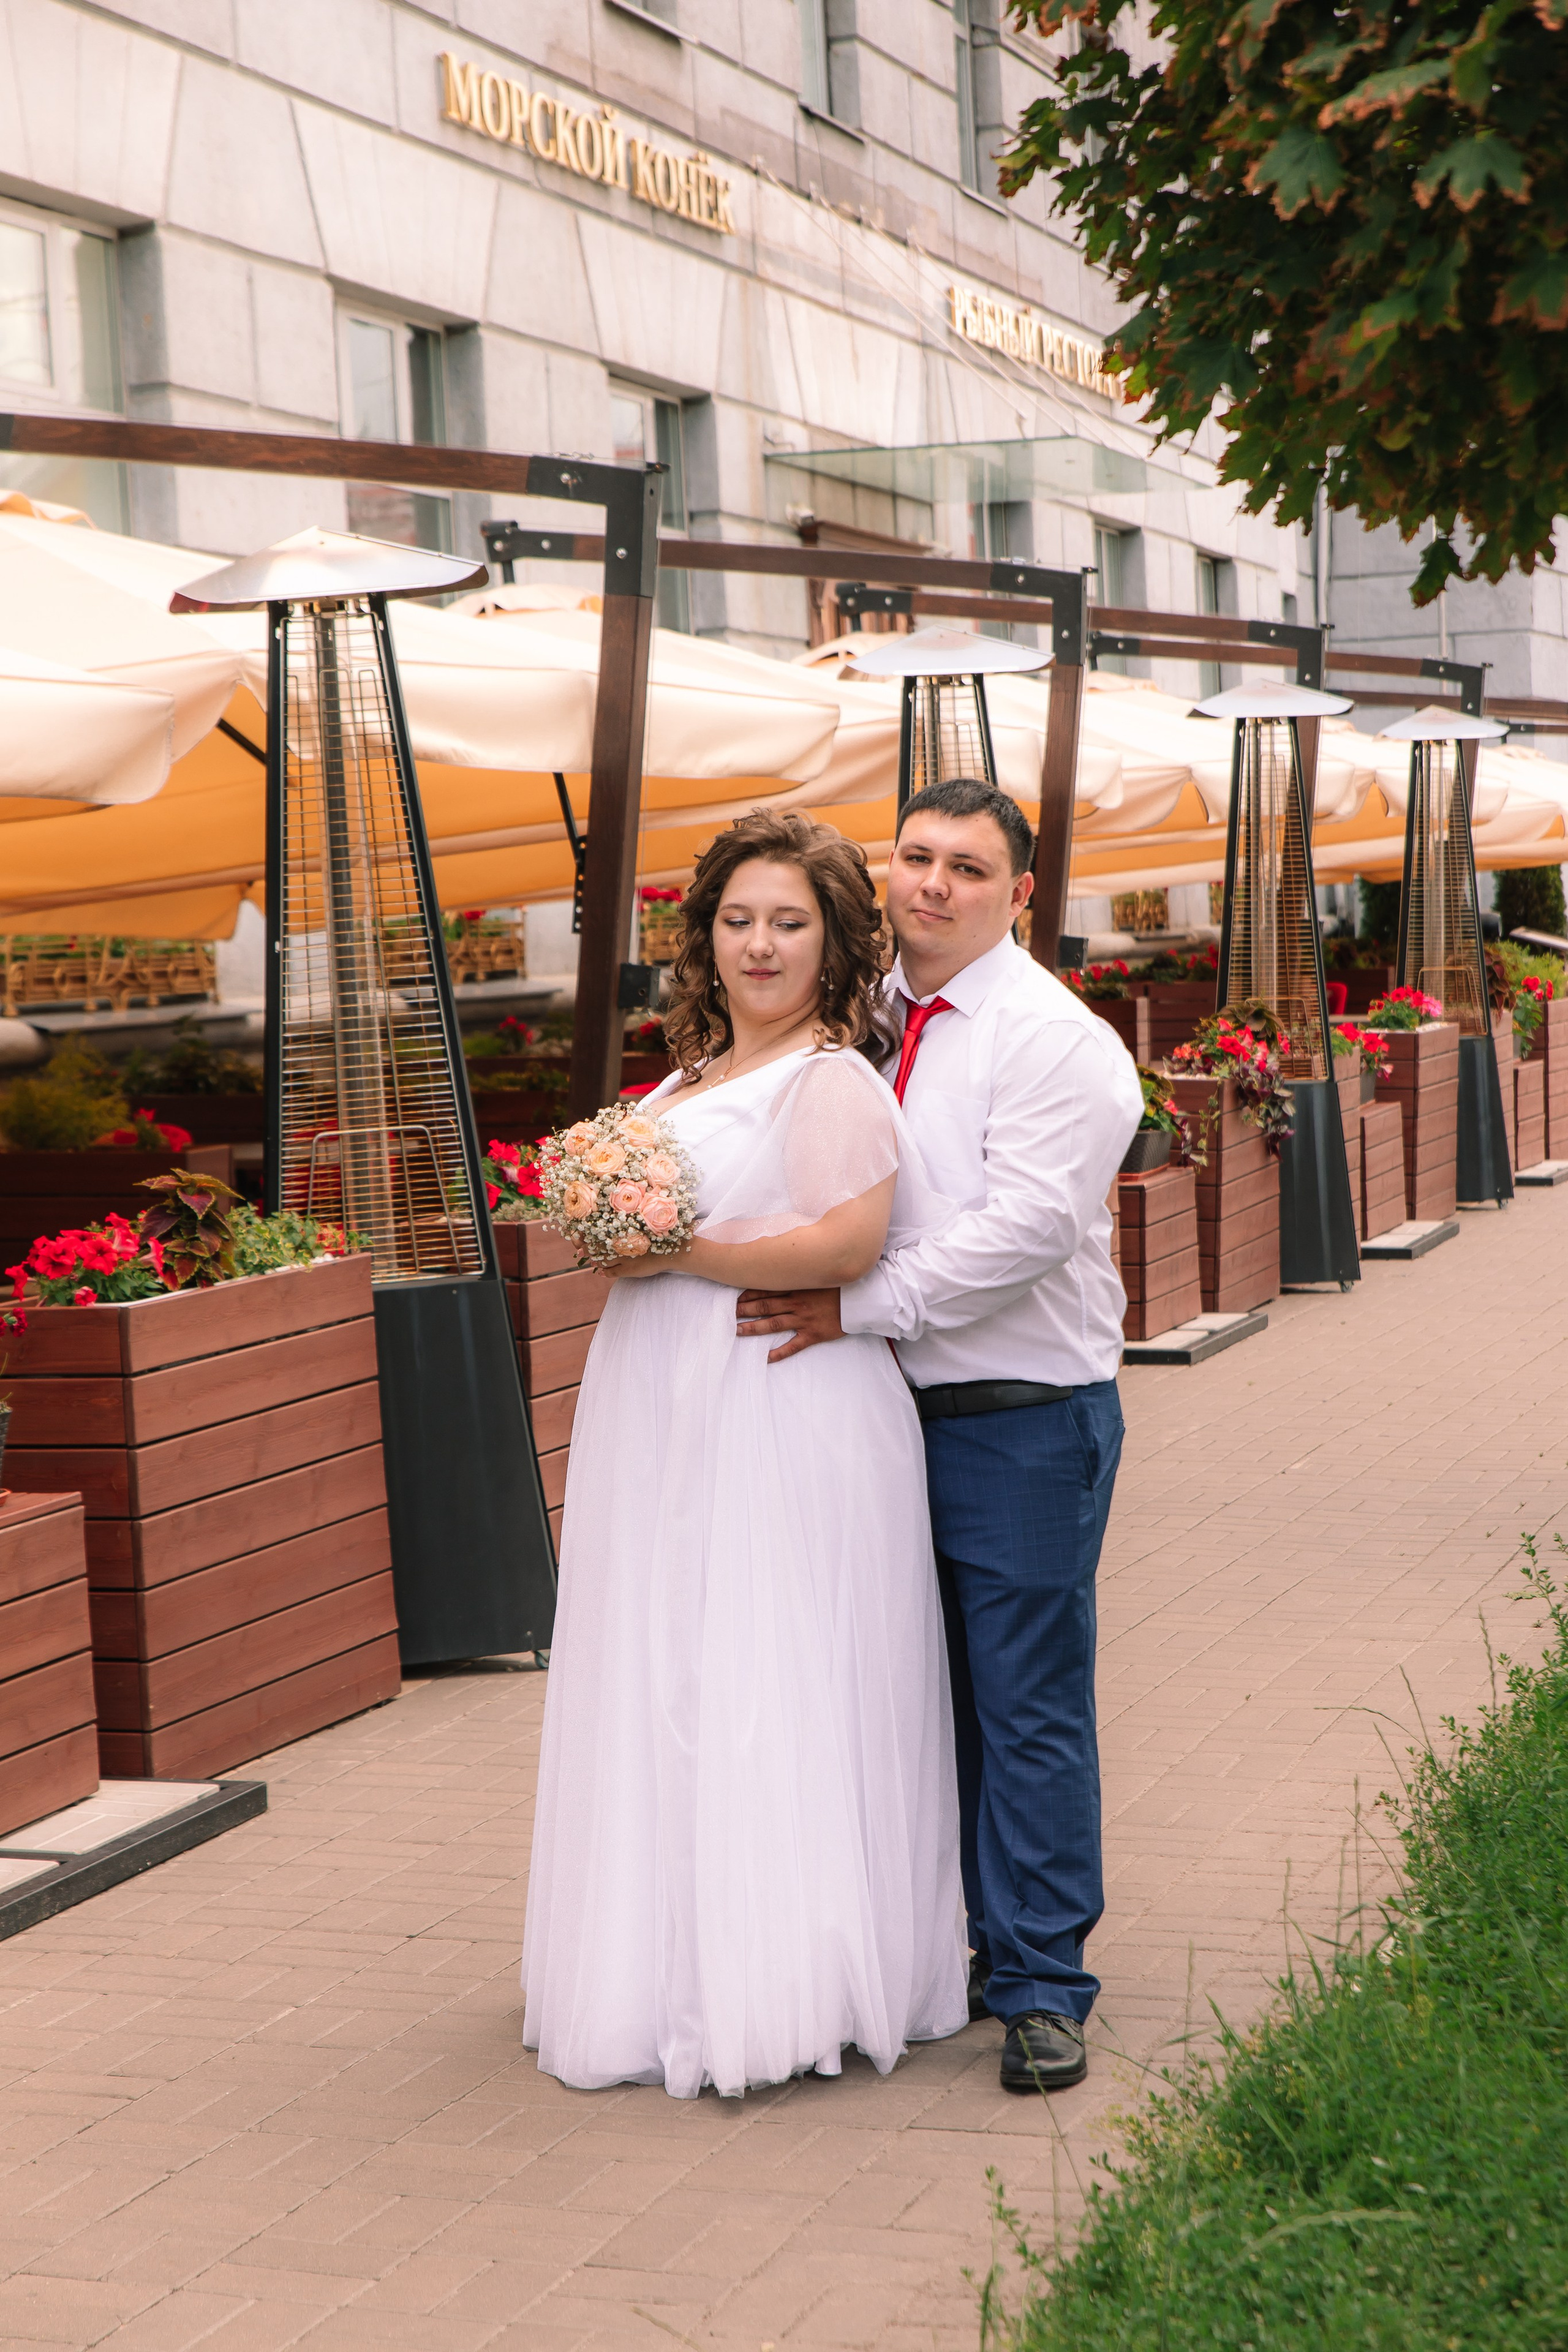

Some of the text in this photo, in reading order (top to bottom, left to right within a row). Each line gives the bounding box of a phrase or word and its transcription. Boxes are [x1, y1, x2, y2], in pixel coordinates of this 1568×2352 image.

[440, 51, 736, 235] МОРСКОЙ КОНЁК
[950, 284, 1121, 399] РЫБНЫЙ РЕСТОРА
